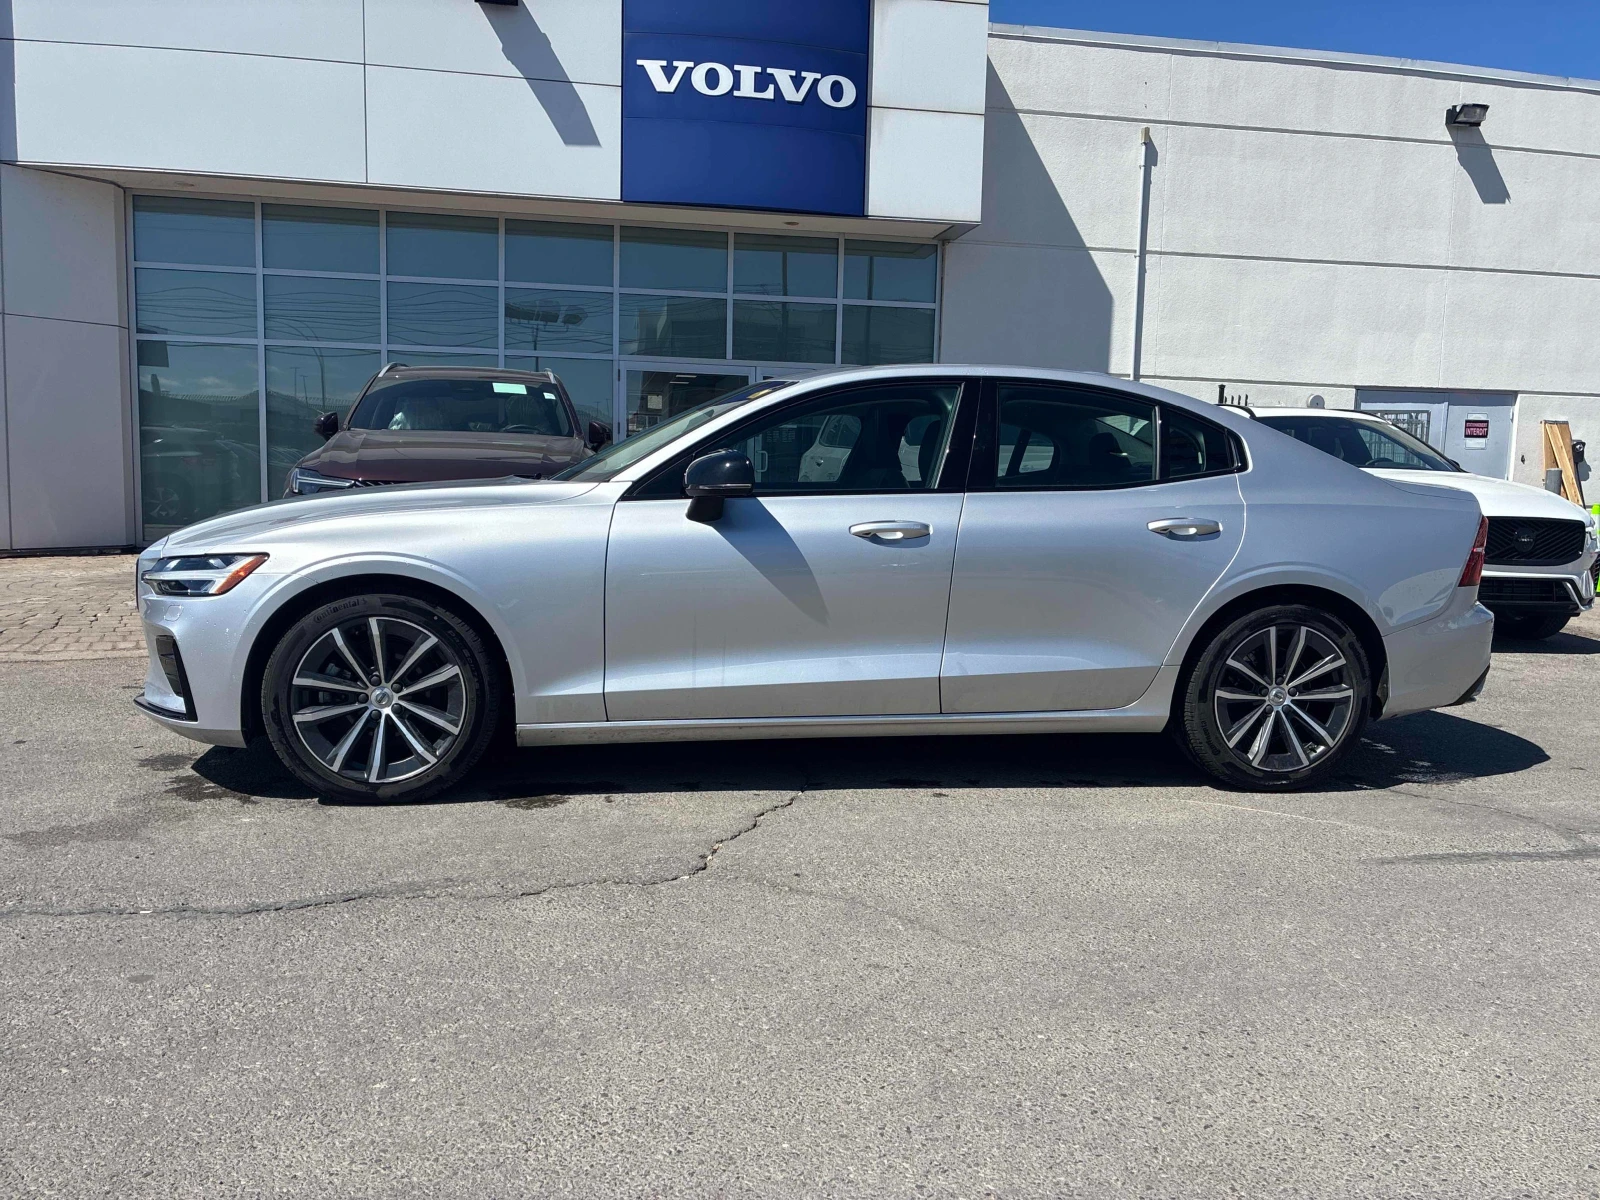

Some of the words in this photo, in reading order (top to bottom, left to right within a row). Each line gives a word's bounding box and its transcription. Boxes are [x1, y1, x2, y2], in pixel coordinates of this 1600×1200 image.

[636, 59, 857, 108] VOLVO
[1465, 428, 1488, 436] INTERDIT
[313, 599, 360, 623] Continental
